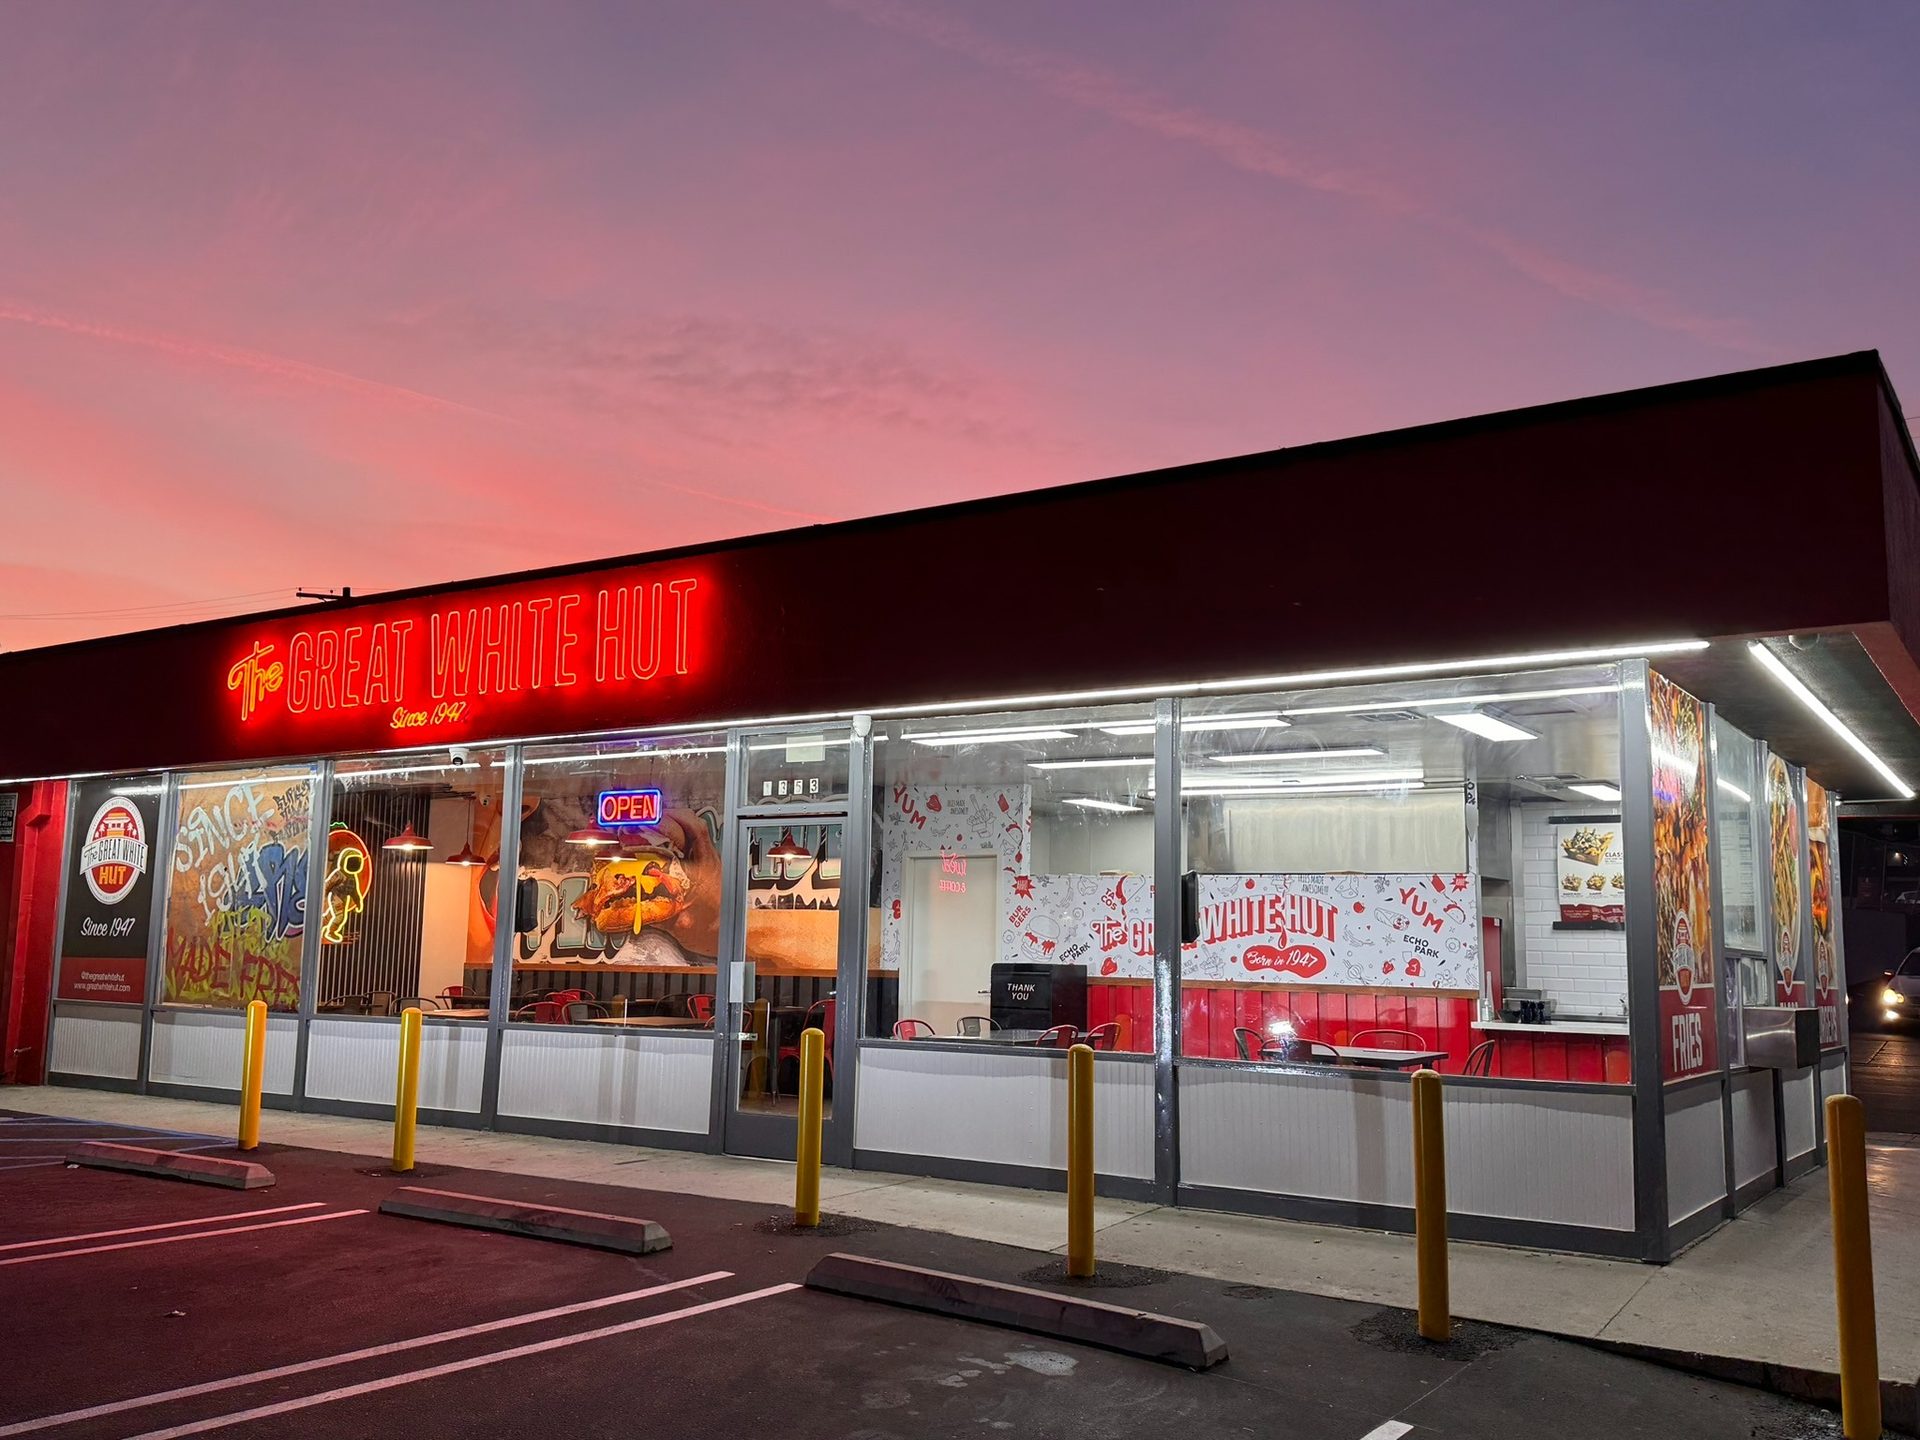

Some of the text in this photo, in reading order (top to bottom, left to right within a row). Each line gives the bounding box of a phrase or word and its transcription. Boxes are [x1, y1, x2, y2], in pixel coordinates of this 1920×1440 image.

[227, 578, 698, 721] The GREAT WHITE HUT
[389, 701, 467, 729] Since 1947
[602, 795, 657, 820] OPEN
[893, 783, 927, 830] YUM
[99, 839, 121, 861] GREAT
[123, 840, 144, 868] WHITE
[99, 866, 127, 885] HUT
[1199, 893, 1284, 945] WHITE
[1285, 893, 1339, 943] HUT
[1399, 887, 1444, 933] YUM
[80, 917, 136, 936] Since 1947
[1090, 915, 1128, 952] The
[1071, 942, 1091, 961] PARK
[1403, 934, 1429, 947] ECHO
[1059, 943, 1079, 962] ECHO
[1246, 949, 1319, 968] Born in 1947
[1414, 945, 1439, 959] PARK
[1007, 983, 1036, 992] THANK
[1011, 992, 1030, 1001] YOU
[1672, 1012, 1703, 1072] FRIES
